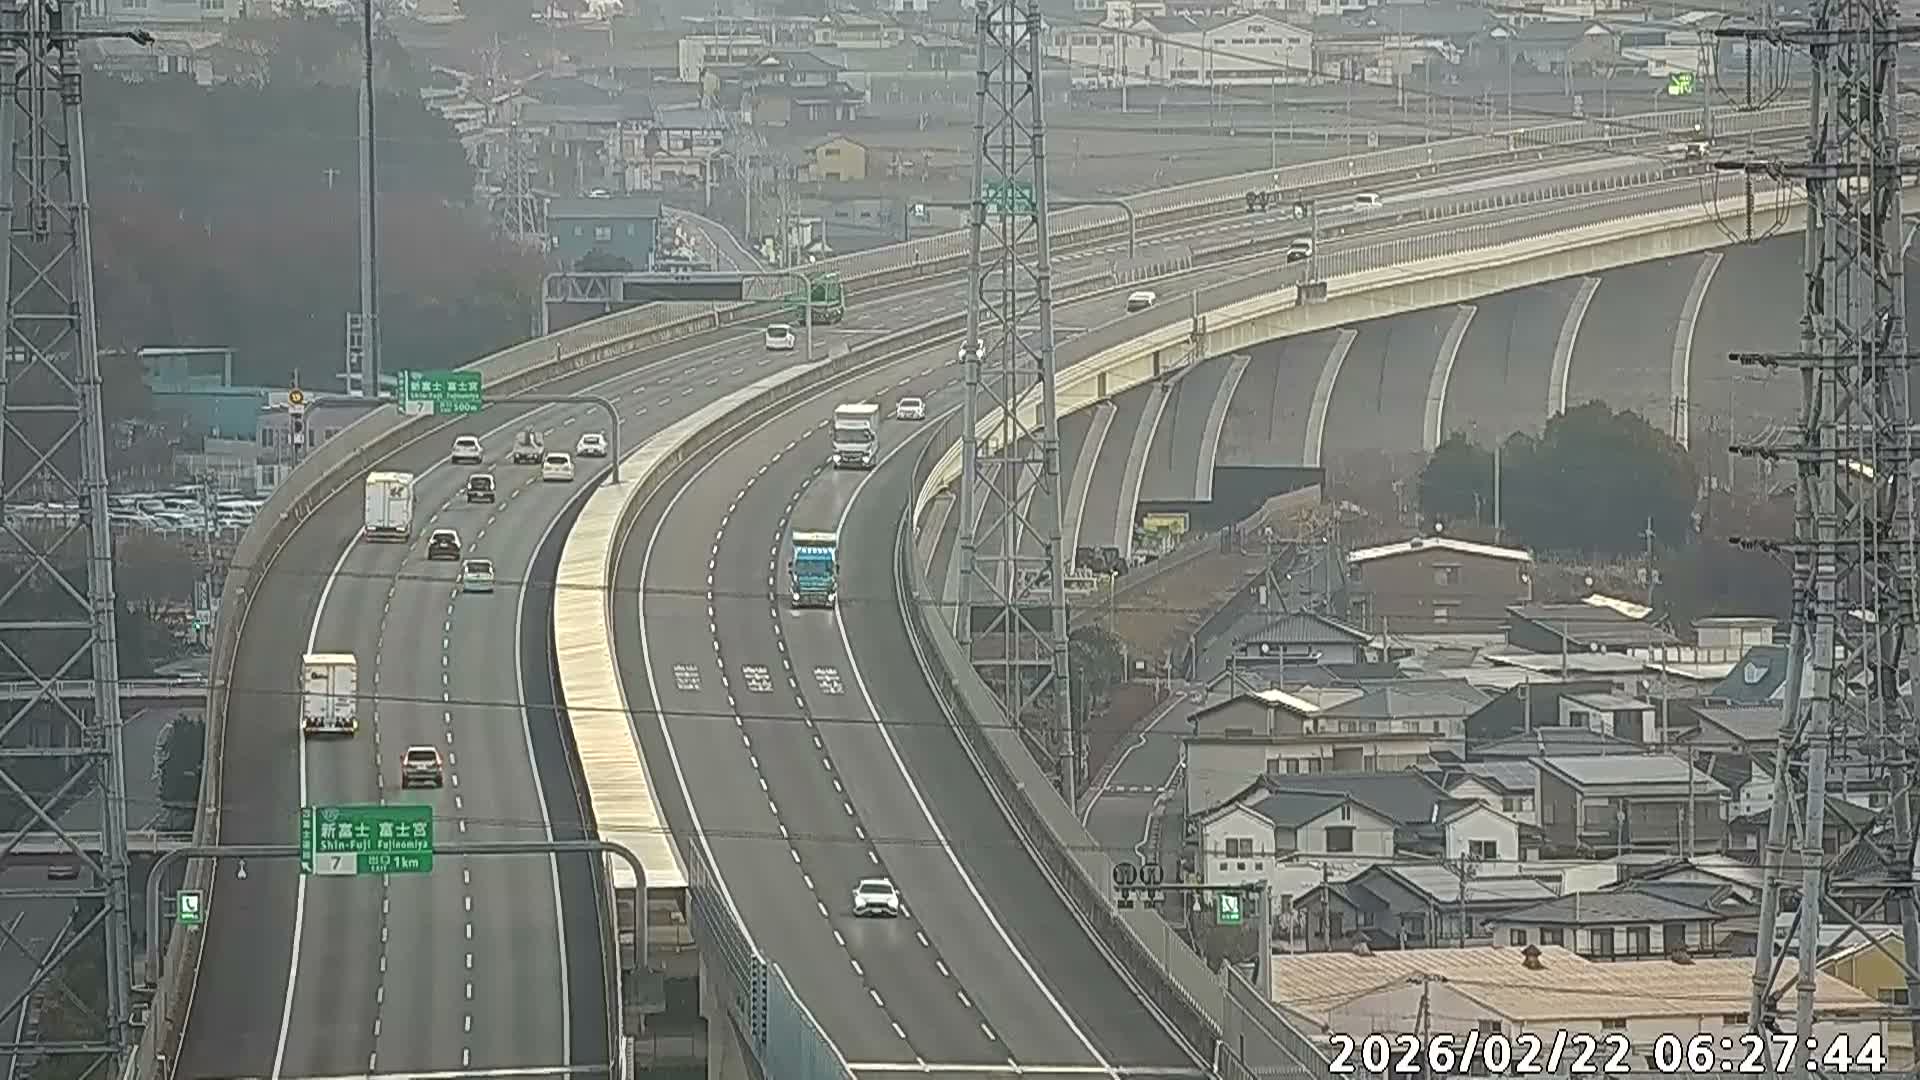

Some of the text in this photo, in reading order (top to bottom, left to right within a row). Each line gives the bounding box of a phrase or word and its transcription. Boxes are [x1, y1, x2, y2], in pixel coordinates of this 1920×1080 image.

[321, 822, 428, 839] 新富士 富士宮
[320, 840, 429, 853] Shin-Fuji Fujinomiya
[330, 855, 342, 871] 7
[393, 856, 420, 870] 1km
